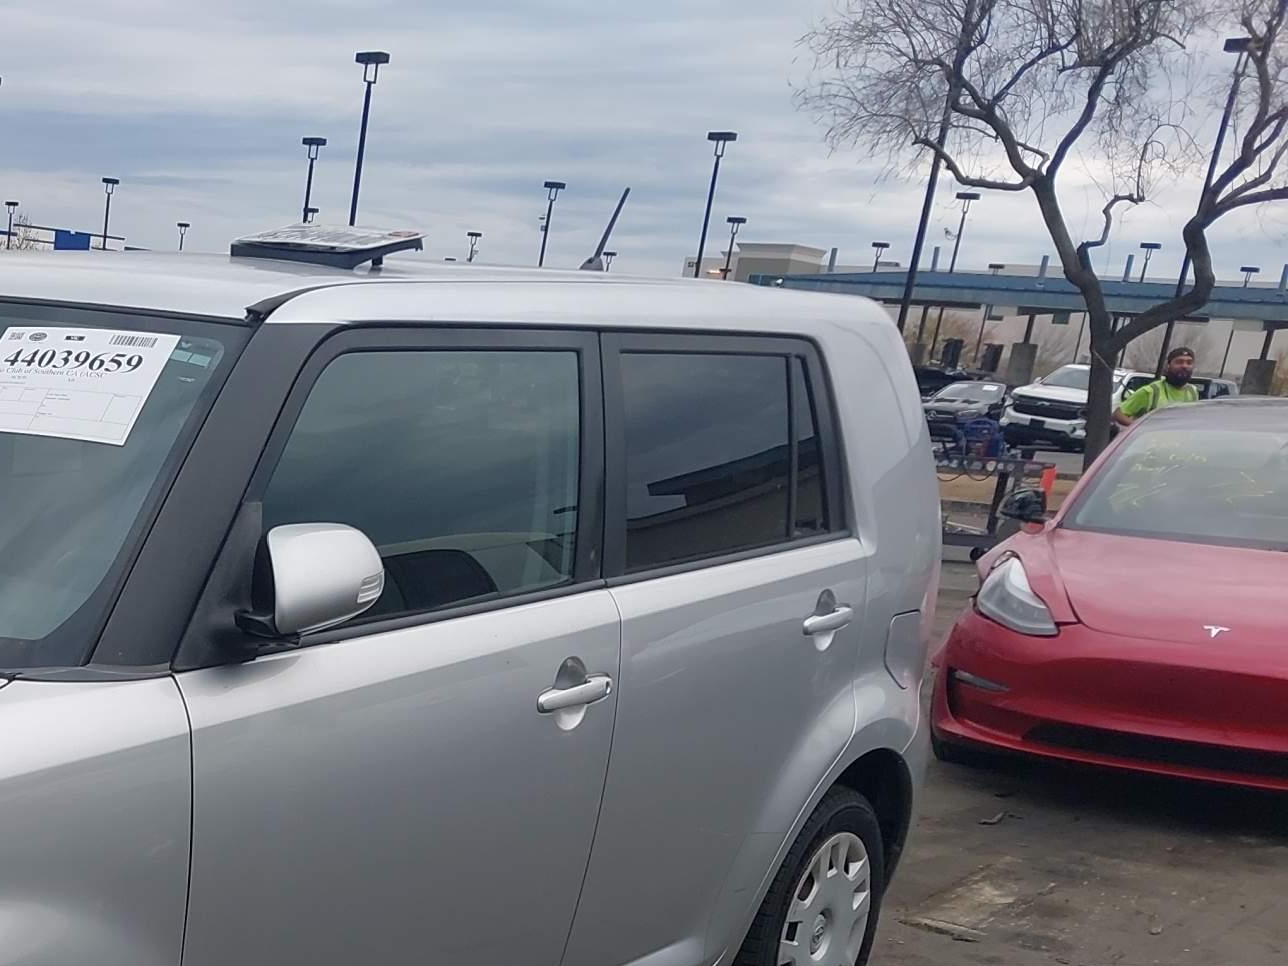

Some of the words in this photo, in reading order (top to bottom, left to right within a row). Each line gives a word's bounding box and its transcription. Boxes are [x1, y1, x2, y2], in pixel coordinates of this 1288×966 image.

[4, 347, 143, 373] 44039659
[6, 367, 24, 375] Club
[33, 367, 65, 377] Southern
